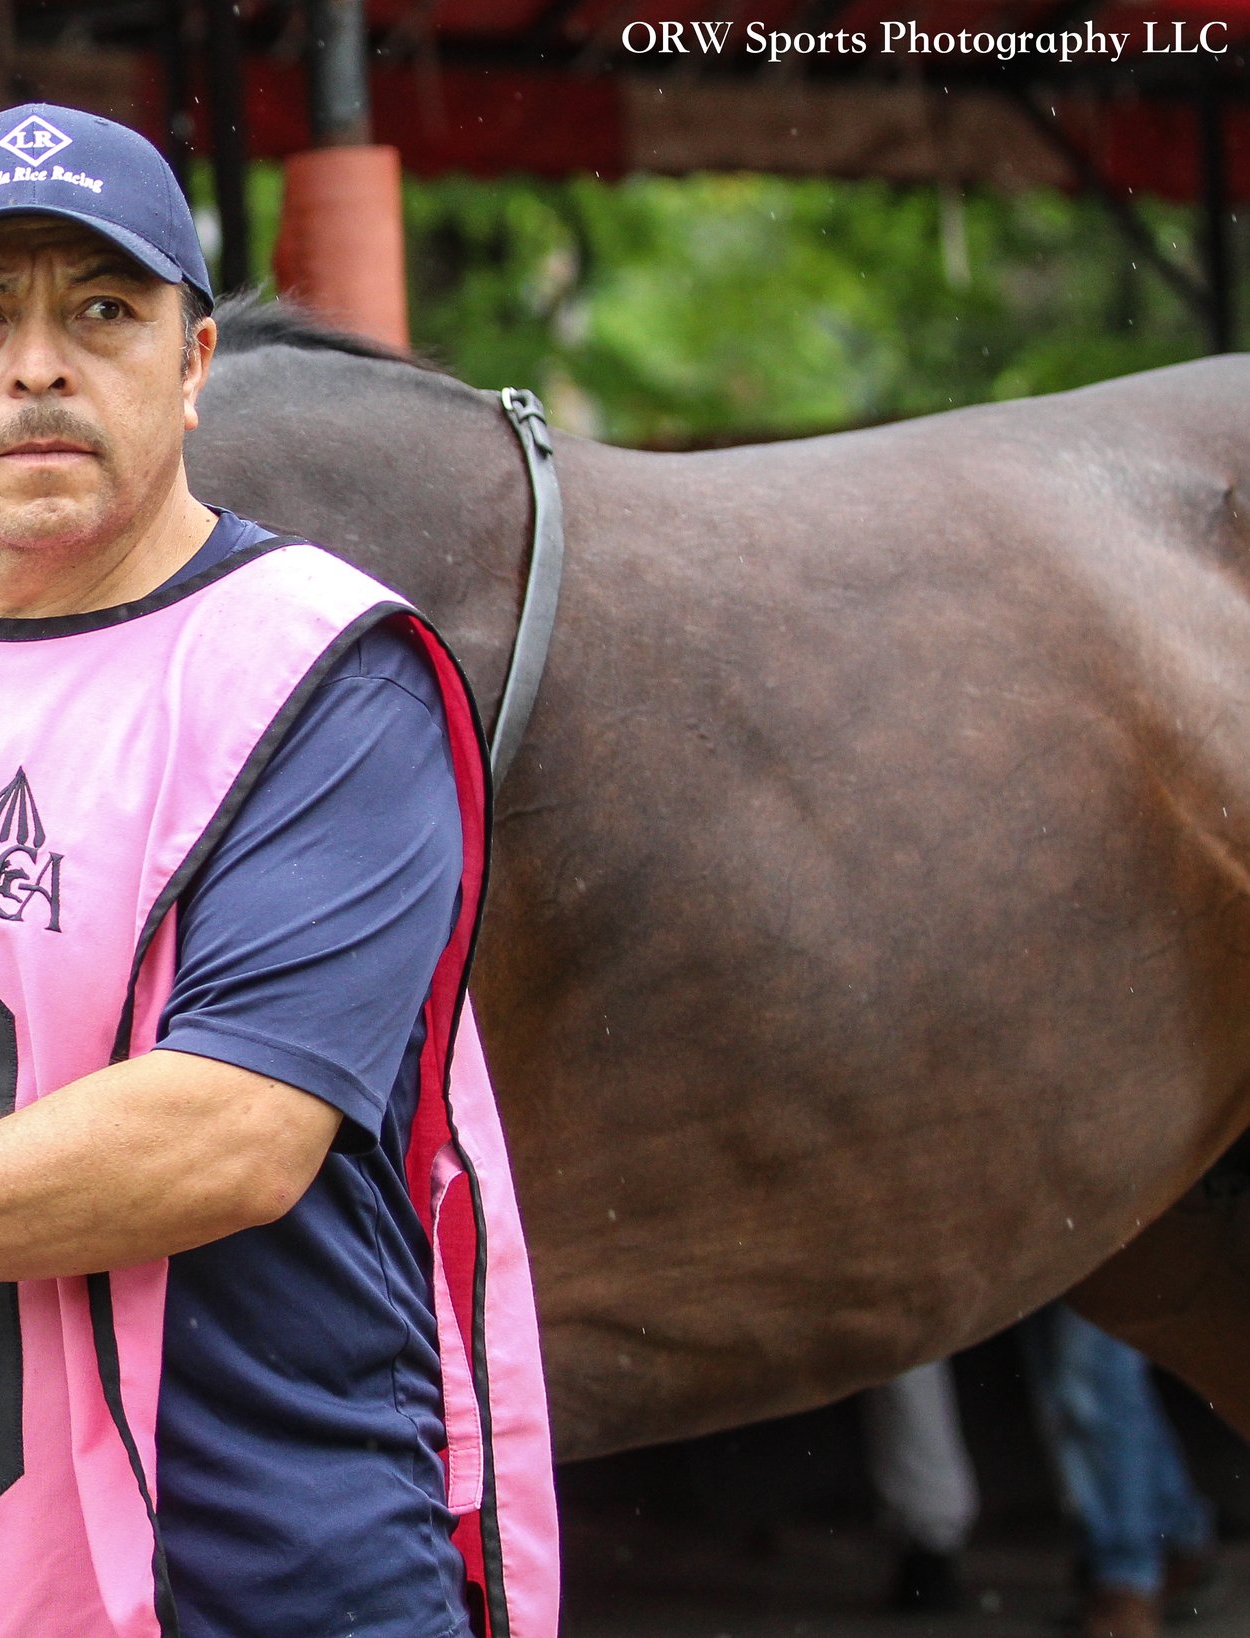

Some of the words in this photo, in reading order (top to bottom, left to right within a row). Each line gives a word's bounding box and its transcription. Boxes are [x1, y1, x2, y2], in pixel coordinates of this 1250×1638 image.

[15, 130, 56, 149] LR
[13, 166, 48, 182] Rice
[50, 165, 104, 194] Racing
